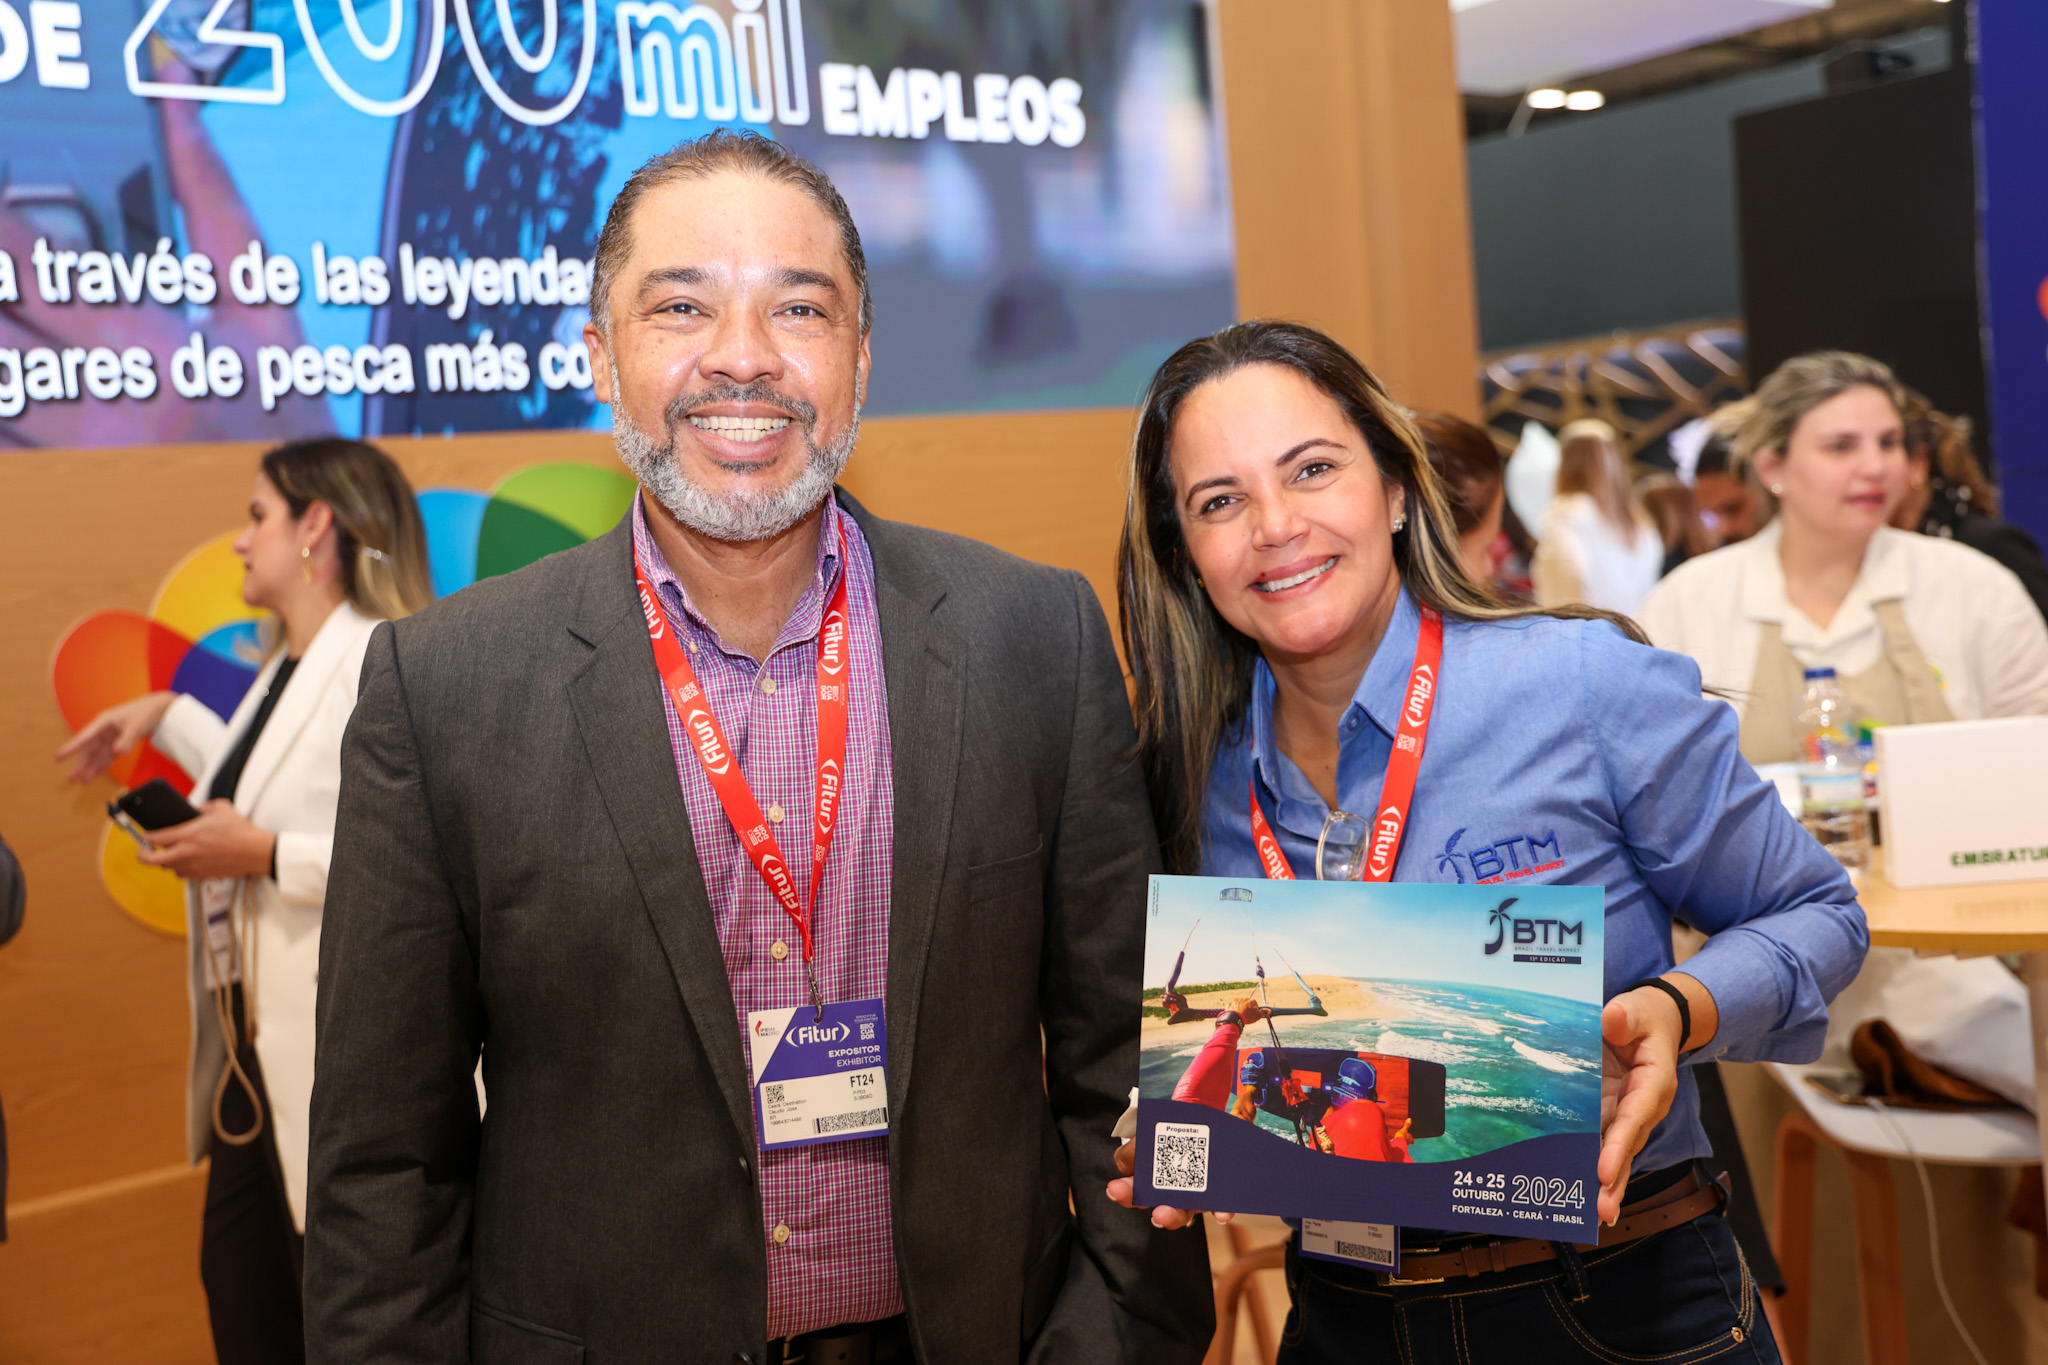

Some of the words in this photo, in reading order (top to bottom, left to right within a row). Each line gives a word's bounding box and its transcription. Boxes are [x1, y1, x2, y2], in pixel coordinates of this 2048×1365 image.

[614, 0, 811, 126] mil
[818, 62, 1087, 148] EMPLEOS
[31, 236, 217, 304] través
[229, 239, 300, 305] de
[311, 241, 391, 305] las
[170, 332, 243, 399] de
[256, 344, 415, 411] pesca
[424, 329, 530, 392] más
[822, 622, 843, 663] Fitur
[1408, 674, 1432, 720] Fitur
[694, 720, 726, 764] Fitur
[820, 773, 839, 823] Fitur
[1373, 820, 1399, 866] Fitur
[1469, 829, 1561, 880] BTM
[1513, 918, 1582, 945] BTM
[798, 1026, 839, 1045] Fitur
[828, 1044, 881, 1058] EXPOSITOR
[836, 1055, 882, 1068] EXHIBITOR
[850, 1073, 875, 1087] FT24
[1166, 1126, 1199, 1134] Proposta:
[1452, 1187, 1505, 1202] OUTUBRO
[1453, 1170, 1473, 1186] 24
[1476, 1175, 1484, 1184] e
[1486, 1173, 1506, 1189] 25
[1511, 1174, 1586, 1209] 2024
[1452, 1204, 1504, 1217] FORTALEZA
[1512, 1209, 1544, 1221] CEARÁ
[1552, 1213, 1585, 1225] BRASIL
